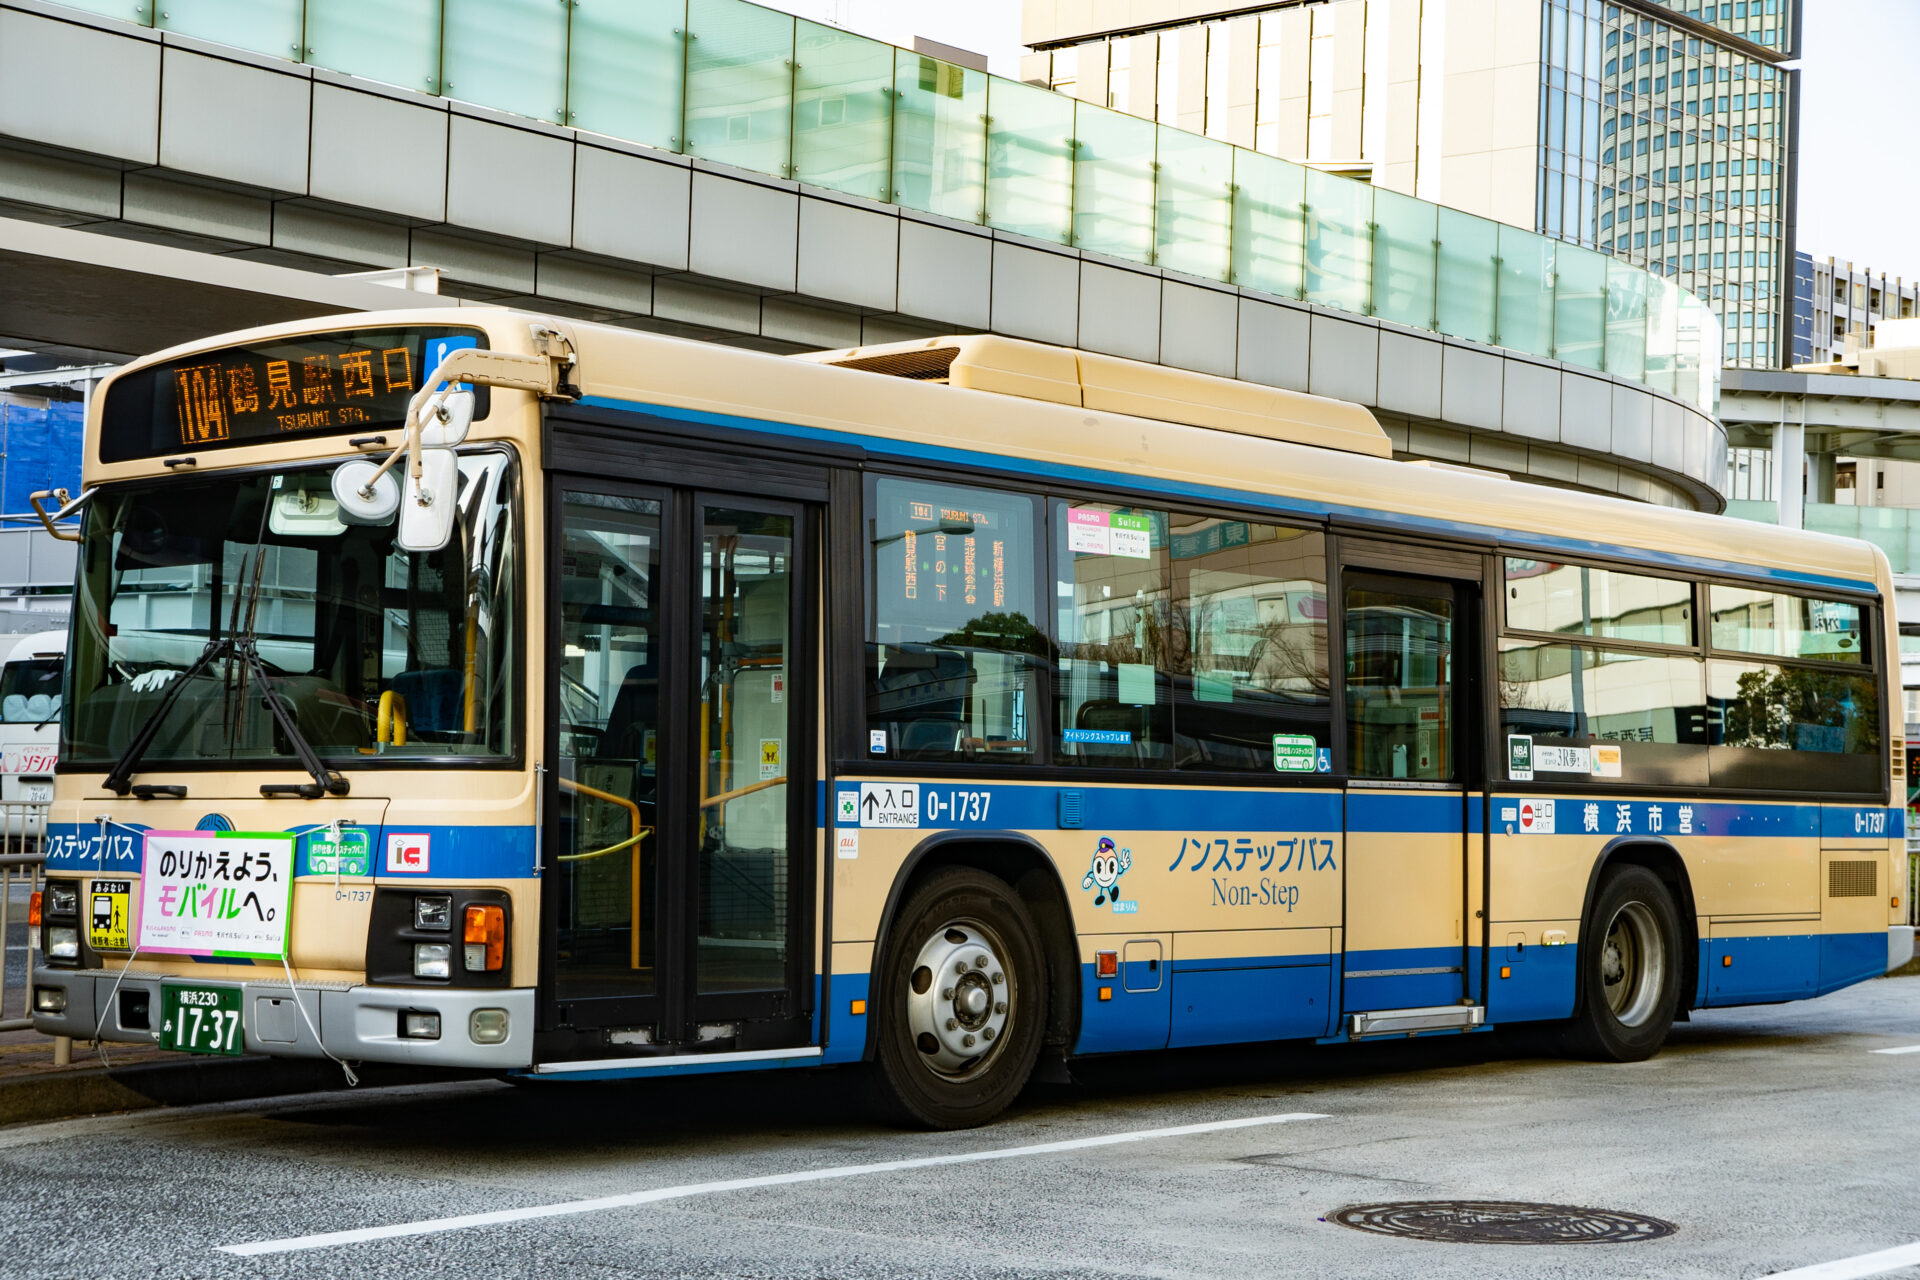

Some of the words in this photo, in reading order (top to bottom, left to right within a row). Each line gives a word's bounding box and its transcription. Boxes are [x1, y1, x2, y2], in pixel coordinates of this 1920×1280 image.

[180, 368, 223, 440] 104
[227, 347, 414, 415] 鶴見駅西口
[277, 410, 331, 432] TSURUMI
[338, 407, 371, 424] STA.
[940, 508, 970, 522] TSURUMI
[972, 512, 989, 525] STA.
[1117, 517, 1142, 529] Suica
[905, 530, 917, 599] 鶴見駅西口
[1065, 731, 1130, 742] アイドリングストップします
[1513, 745, 1528, 758] NBA
[883, 788, 914, 809] 入口
[878, 812, 918, 824] ENTRANCE
[1534, 802, 1553, 818] 出口
[1583, 802, 1694, 834] 横浜市営
[1536, 821, 1551, 830] EXIT
[840, 837, 856, 848] au
[1168, 837, 1337, 873] ノンステップバス
[159, 850, 278, 882] のりかえよう、
[95, 882, 125, 893] あぶない
[1211, 877, 1299, 912] Non-Step
[158, 883, 276, 922] モバイルへ。
[1113, 902, 1137, 912] はまりん
[163, 1018, 172, 1032] あ
[177, 1007, 239, 1050] 17-37
